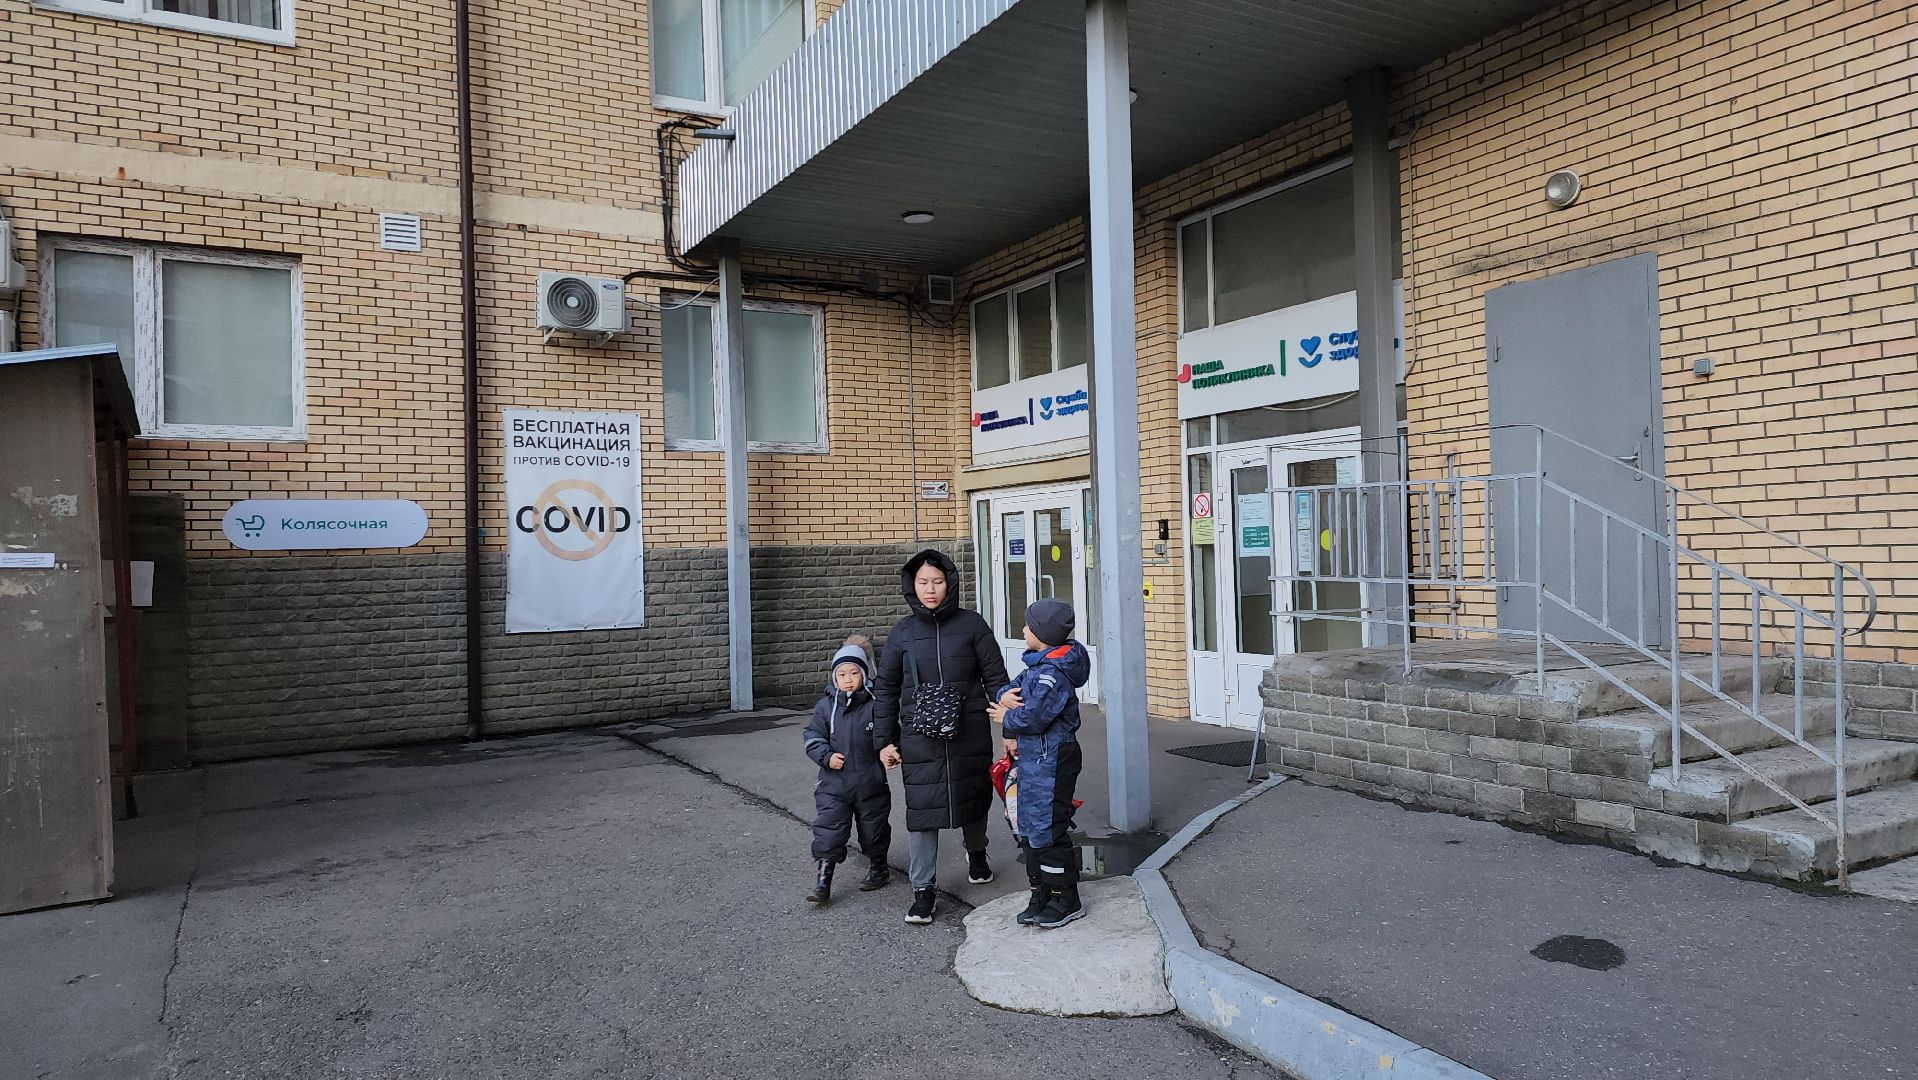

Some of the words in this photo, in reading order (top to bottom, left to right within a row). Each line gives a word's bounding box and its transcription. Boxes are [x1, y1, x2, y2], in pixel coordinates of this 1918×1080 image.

[1191, 363, 1276, 390] ПОЛИКЛИНИКА
[513, 418, 630, 435] БЕСПЛАТНАЯ
[513, 435, 631, 453] ВАКЦИНАЦИЯ
[513, 456, 561, 466] ПРОТИВ
[564, 455, 630, 467] COVID-19
[281, 517, 388, 531] Колясочная
[515, 505, 631, 533] COVID
